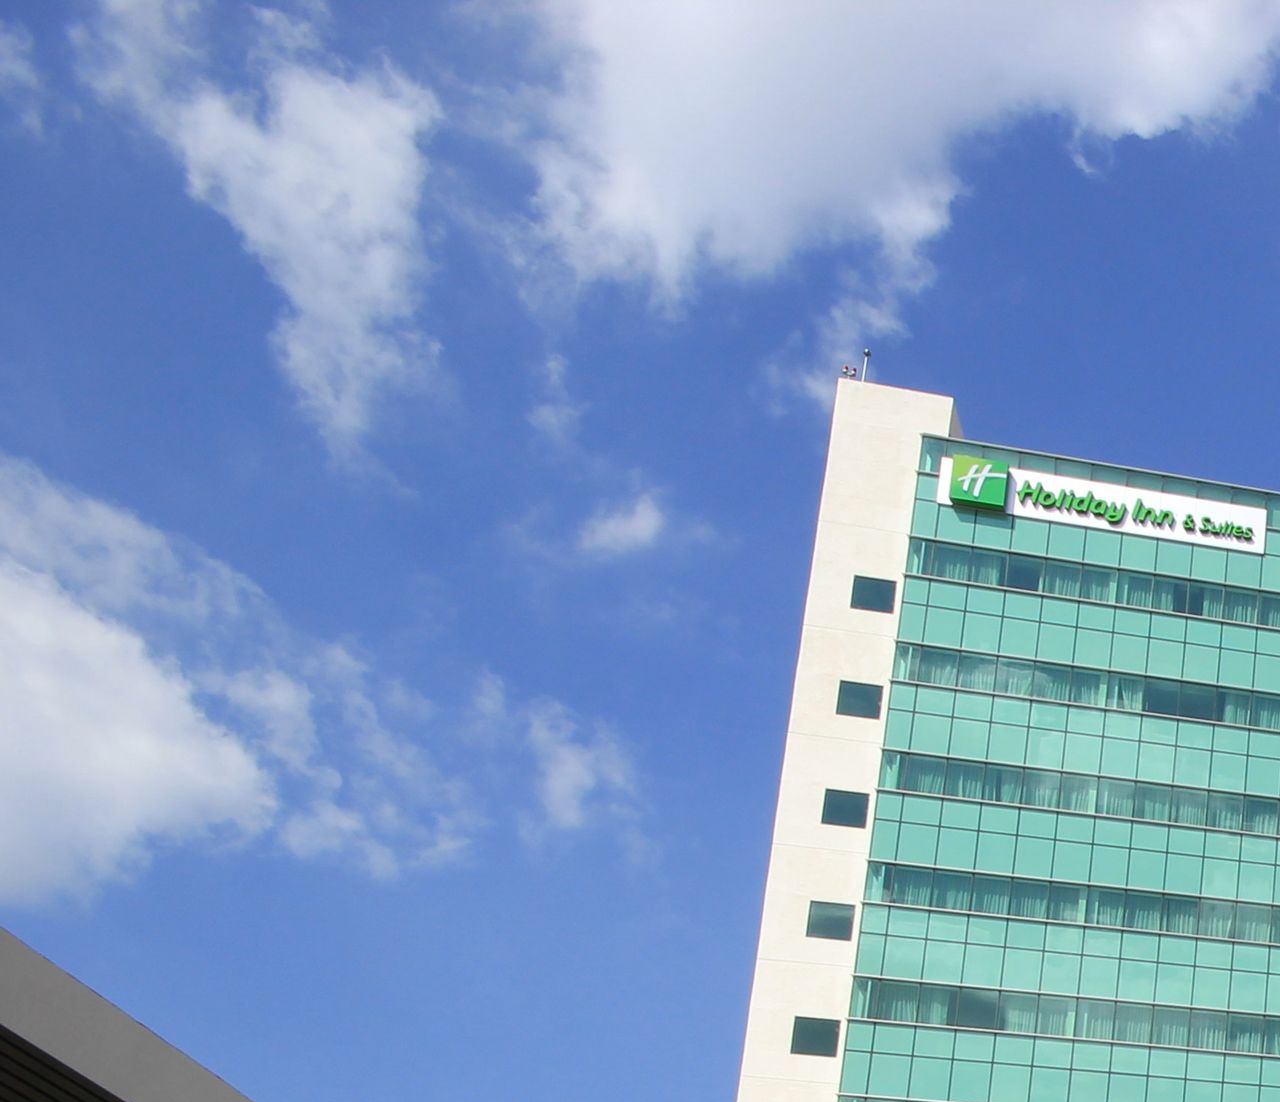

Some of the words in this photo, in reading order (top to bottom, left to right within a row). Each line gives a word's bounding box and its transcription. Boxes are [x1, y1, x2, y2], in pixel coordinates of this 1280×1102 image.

[1016, 480, 1128, 524] Holiday
[1132, 498, 1176, 526] Inn
[1182, 514, 1197, 531] &
[1199, 517, 1254, 540] Suites
